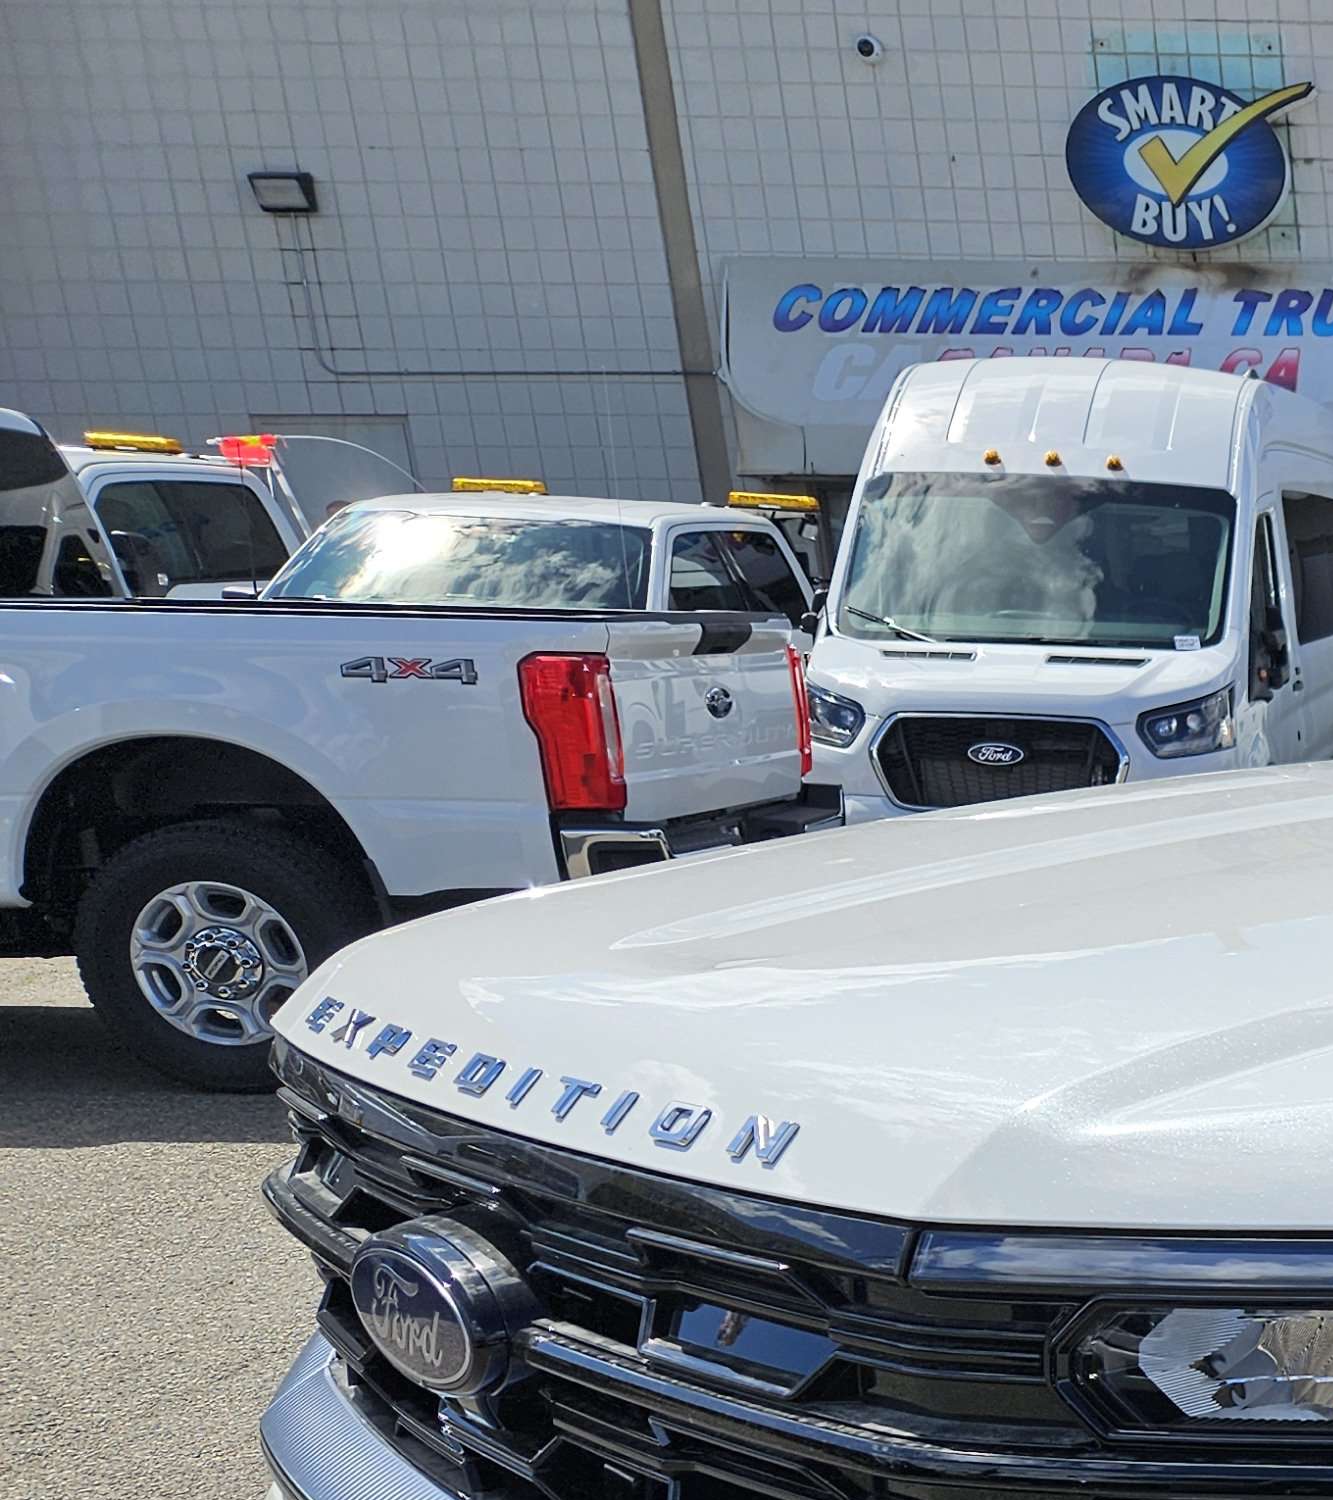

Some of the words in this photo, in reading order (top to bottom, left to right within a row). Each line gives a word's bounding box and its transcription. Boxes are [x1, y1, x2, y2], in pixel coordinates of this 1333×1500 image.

[1097, 82, 1243, 142] SMART
[1131, 193, 1238, 243] BUY!
[772, 283, 1205, 337] COMMERCIAL
[975, 745, 1016, 763] Ford
[304, 995, 802, 1169] EXPEDITION
[372, 1263, 444, 1368] Ford
